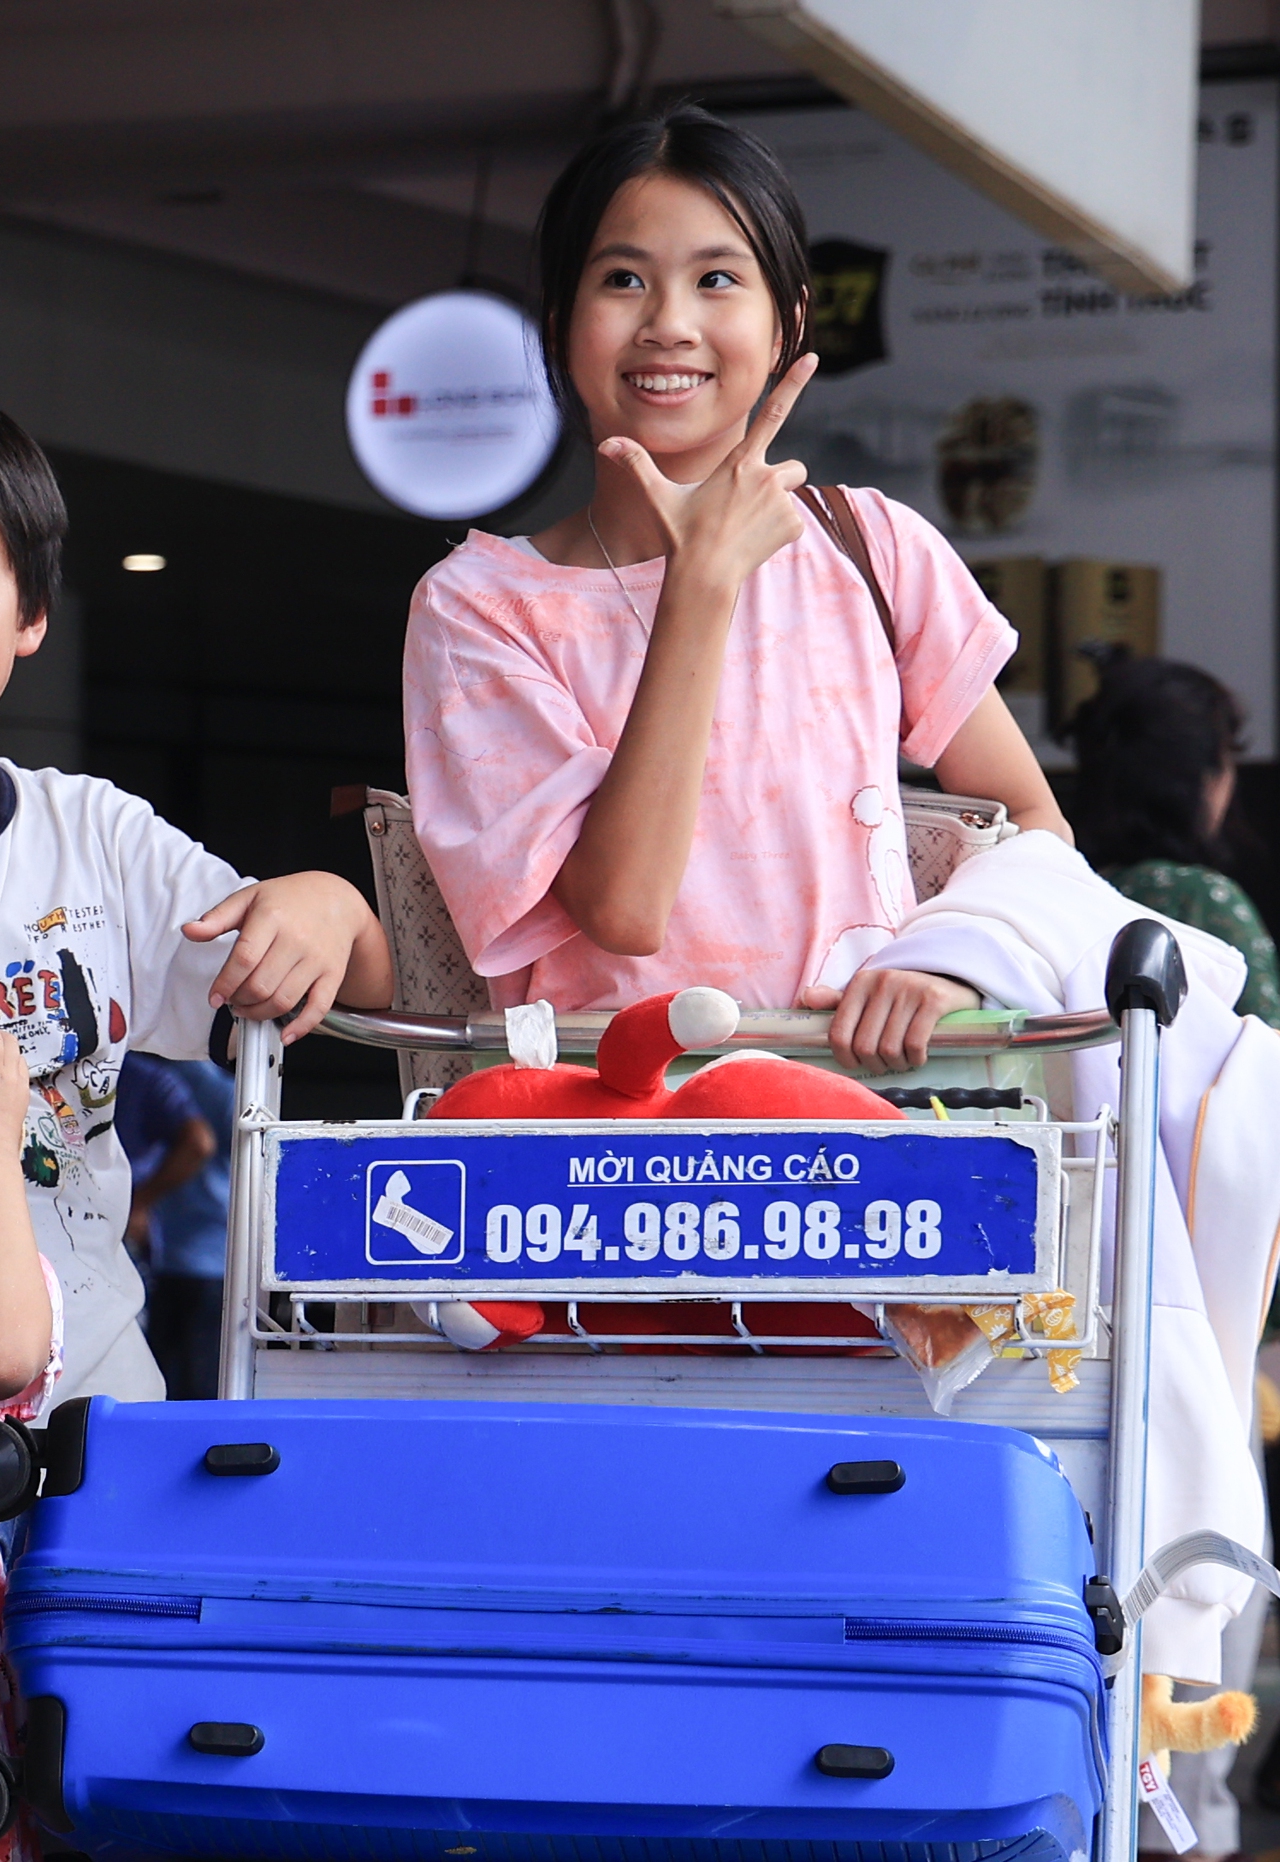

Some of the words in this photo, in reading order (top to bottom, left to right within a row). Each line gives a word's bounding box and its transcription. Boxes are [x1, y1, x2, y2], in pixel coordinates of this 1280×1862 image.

[568, 1150, 634, 1183] MỜI
[645, 1150, 773, 1183] QUẢNG
[783, 1148, 860, 1182] CÁO
[486, 1199, 942, 1264] 094.986.98.98
